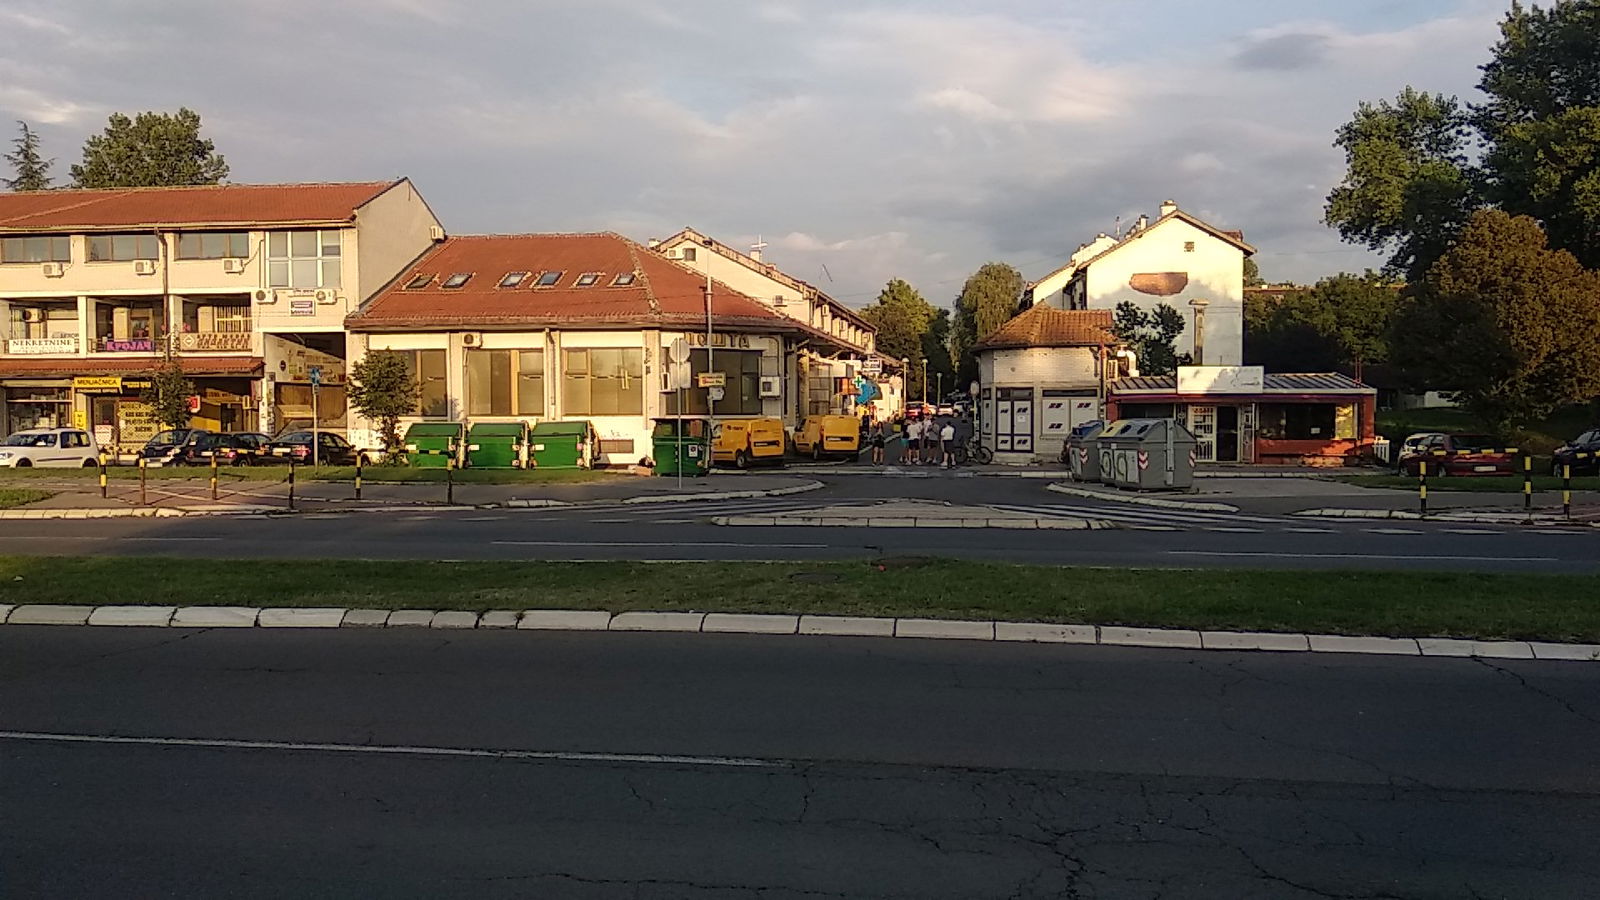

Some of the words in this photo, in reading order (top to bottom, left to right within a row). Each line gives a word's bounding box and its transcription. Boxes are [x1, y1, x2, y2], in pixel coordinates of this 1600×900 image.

[12, 339, 73, 347] NEKRETNINE
[684, 332, 750, 348] ПОШТА
[76, 378, 117, 386] MENJAČNICA
